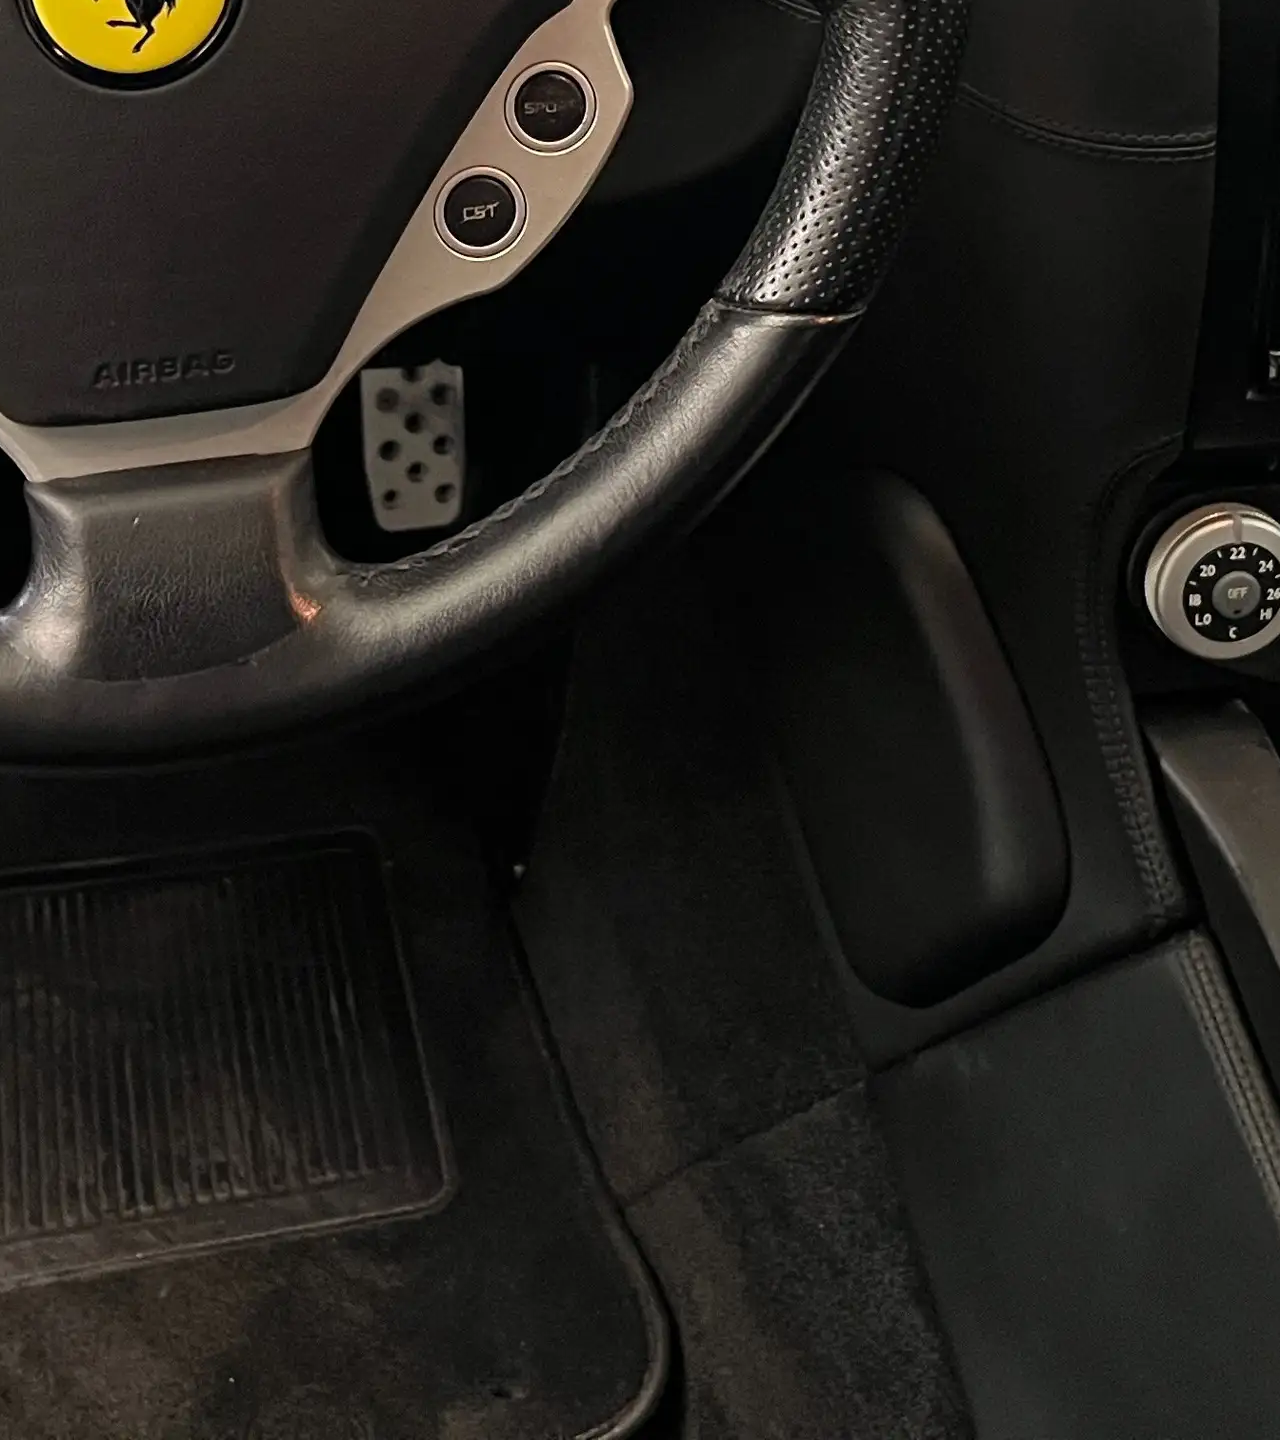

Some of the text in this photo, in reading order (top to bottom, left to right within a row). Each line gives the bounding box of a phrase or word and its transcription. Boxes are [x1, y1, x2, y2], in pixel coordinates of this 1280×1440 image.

[92, 349, 237, 390] AIRBAG
[1229, 546, 1246, 560] 22
[1199, 564, 1216, 577] 20
[1258, 559, 1274, 573] 24
[1266, 587, 1280, 601] 26
[1194, 613, 1212, 626] LO
[1260, 607, 1273, 621] HI
